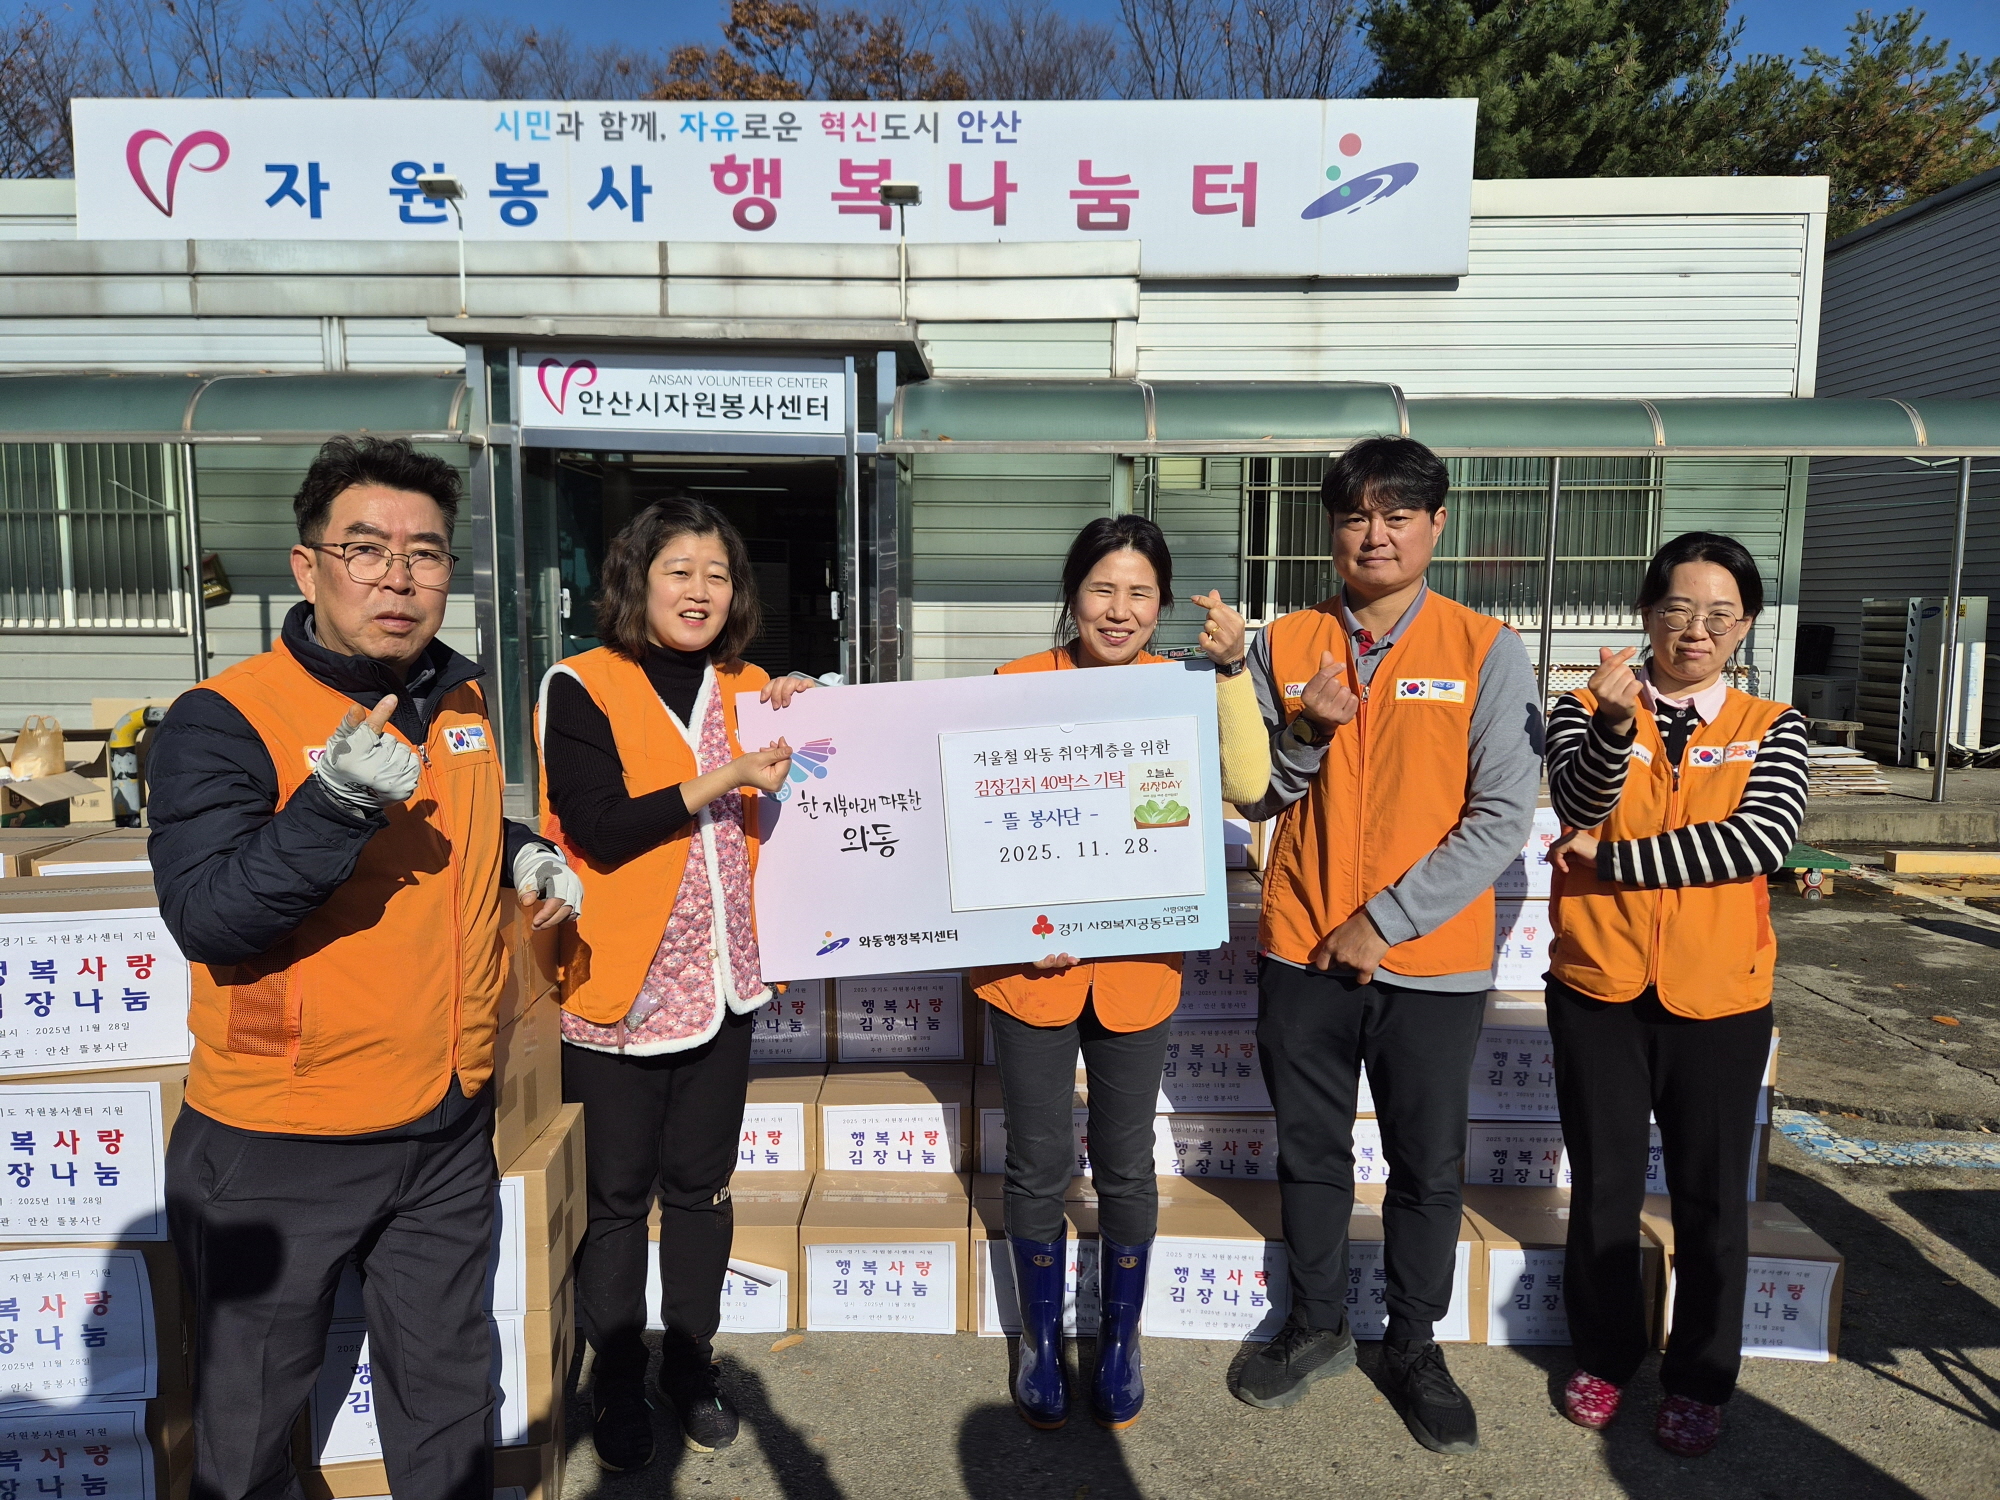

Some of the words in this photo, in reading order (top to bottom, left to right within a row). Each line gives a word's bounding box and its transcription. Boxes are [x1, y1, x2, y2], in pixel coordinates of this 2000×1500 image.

[494, 110, 584, 142] 시민과
[599, 111, 666, 142] 함께,
[679, 111, 802, 143] 자유로운
[819, 111, 939, 144] 혁신도시
[957, 110, 1022, 144] 안산
[648, 374, 692, 386] ANSAN
[698, 375, 773, 388] VOLUNTEER
[777, 377, 828, 389] CENTER
[578, 390, 829, 421] 안산시자원봉사센터
[973, 748, 1017, 767] 겨울철
[1023, 746, 1054, 763] 와동
[1058, 741, 1135, 761] 취약계층을
[1140, 738, 1171, 756] 위한
[1146, 767, 1174, 778] 오늘은
[974, 775, 1036, 797] 김장김치
[1040, 772, 1090, 791] 40박스
[1094, 770, 1126, 788] 기탁
[1139, 780, 1182, 792] 김장DAY
[798, 789, 818, 819] 한
[878, 788, 922, 812] 따뜻한
[1001, 811, 1021, 831] 뜰
[1028, 807, 1082, 828] 봉사단
[840, 823, 900, 857] 와동
[1000, 843, 1061, 864] 2025.
[1077, 840, 1109, 859] 11.
[1124, 837, 1158, 855] 28.
[1058, 921, 1083, 936] 경기
[1087, 914, 1200, 932] 사회복지공동모금회
[0, 936, 37, 947] 경기도
[47, 932, 124, 945] 자원봉사센터
[133, 931, 156, 941] 지원
[858, 928, 959, 949] 와동행정복지센터
[35, 1026, 71, 1036] 2025년
[79, 1024, 100, 1033] 11월
[108, 1022, 130, 1031] 28일
[1, 1049, 25, 1060] 주관
[46, 1046, 70, 1057] 안산
[79, 1042, 128, 1054] 뜰봉사단
[25, 1106, 93, 1118] 자원봉사센터
[102, 1106, 124, 1116] 지원
[18, 1197, 49, 1206] 2025년
[57, 1197, 76, 1205] 11월
[83, 1196, 102, 1205] 28일
[28, 1217, 48, 1227] 안산
[57, 1217, 101, 1226] 뜰봉사단
[10, 1269, 80, 1283] 자원봉사센터
[90, 1268, 111, 1277] 지원
[2, 1361, 34, 1371] 2025년
[43, 1359, 61, 1368] 11월
[11, 1382, 33, 1393] 안산
[42, 1376, 89, 1390] 뜰봉사단
[7, 1429, 76, 1440] 자원봉사센터
[86, 1428, 107, 1437] 지원
